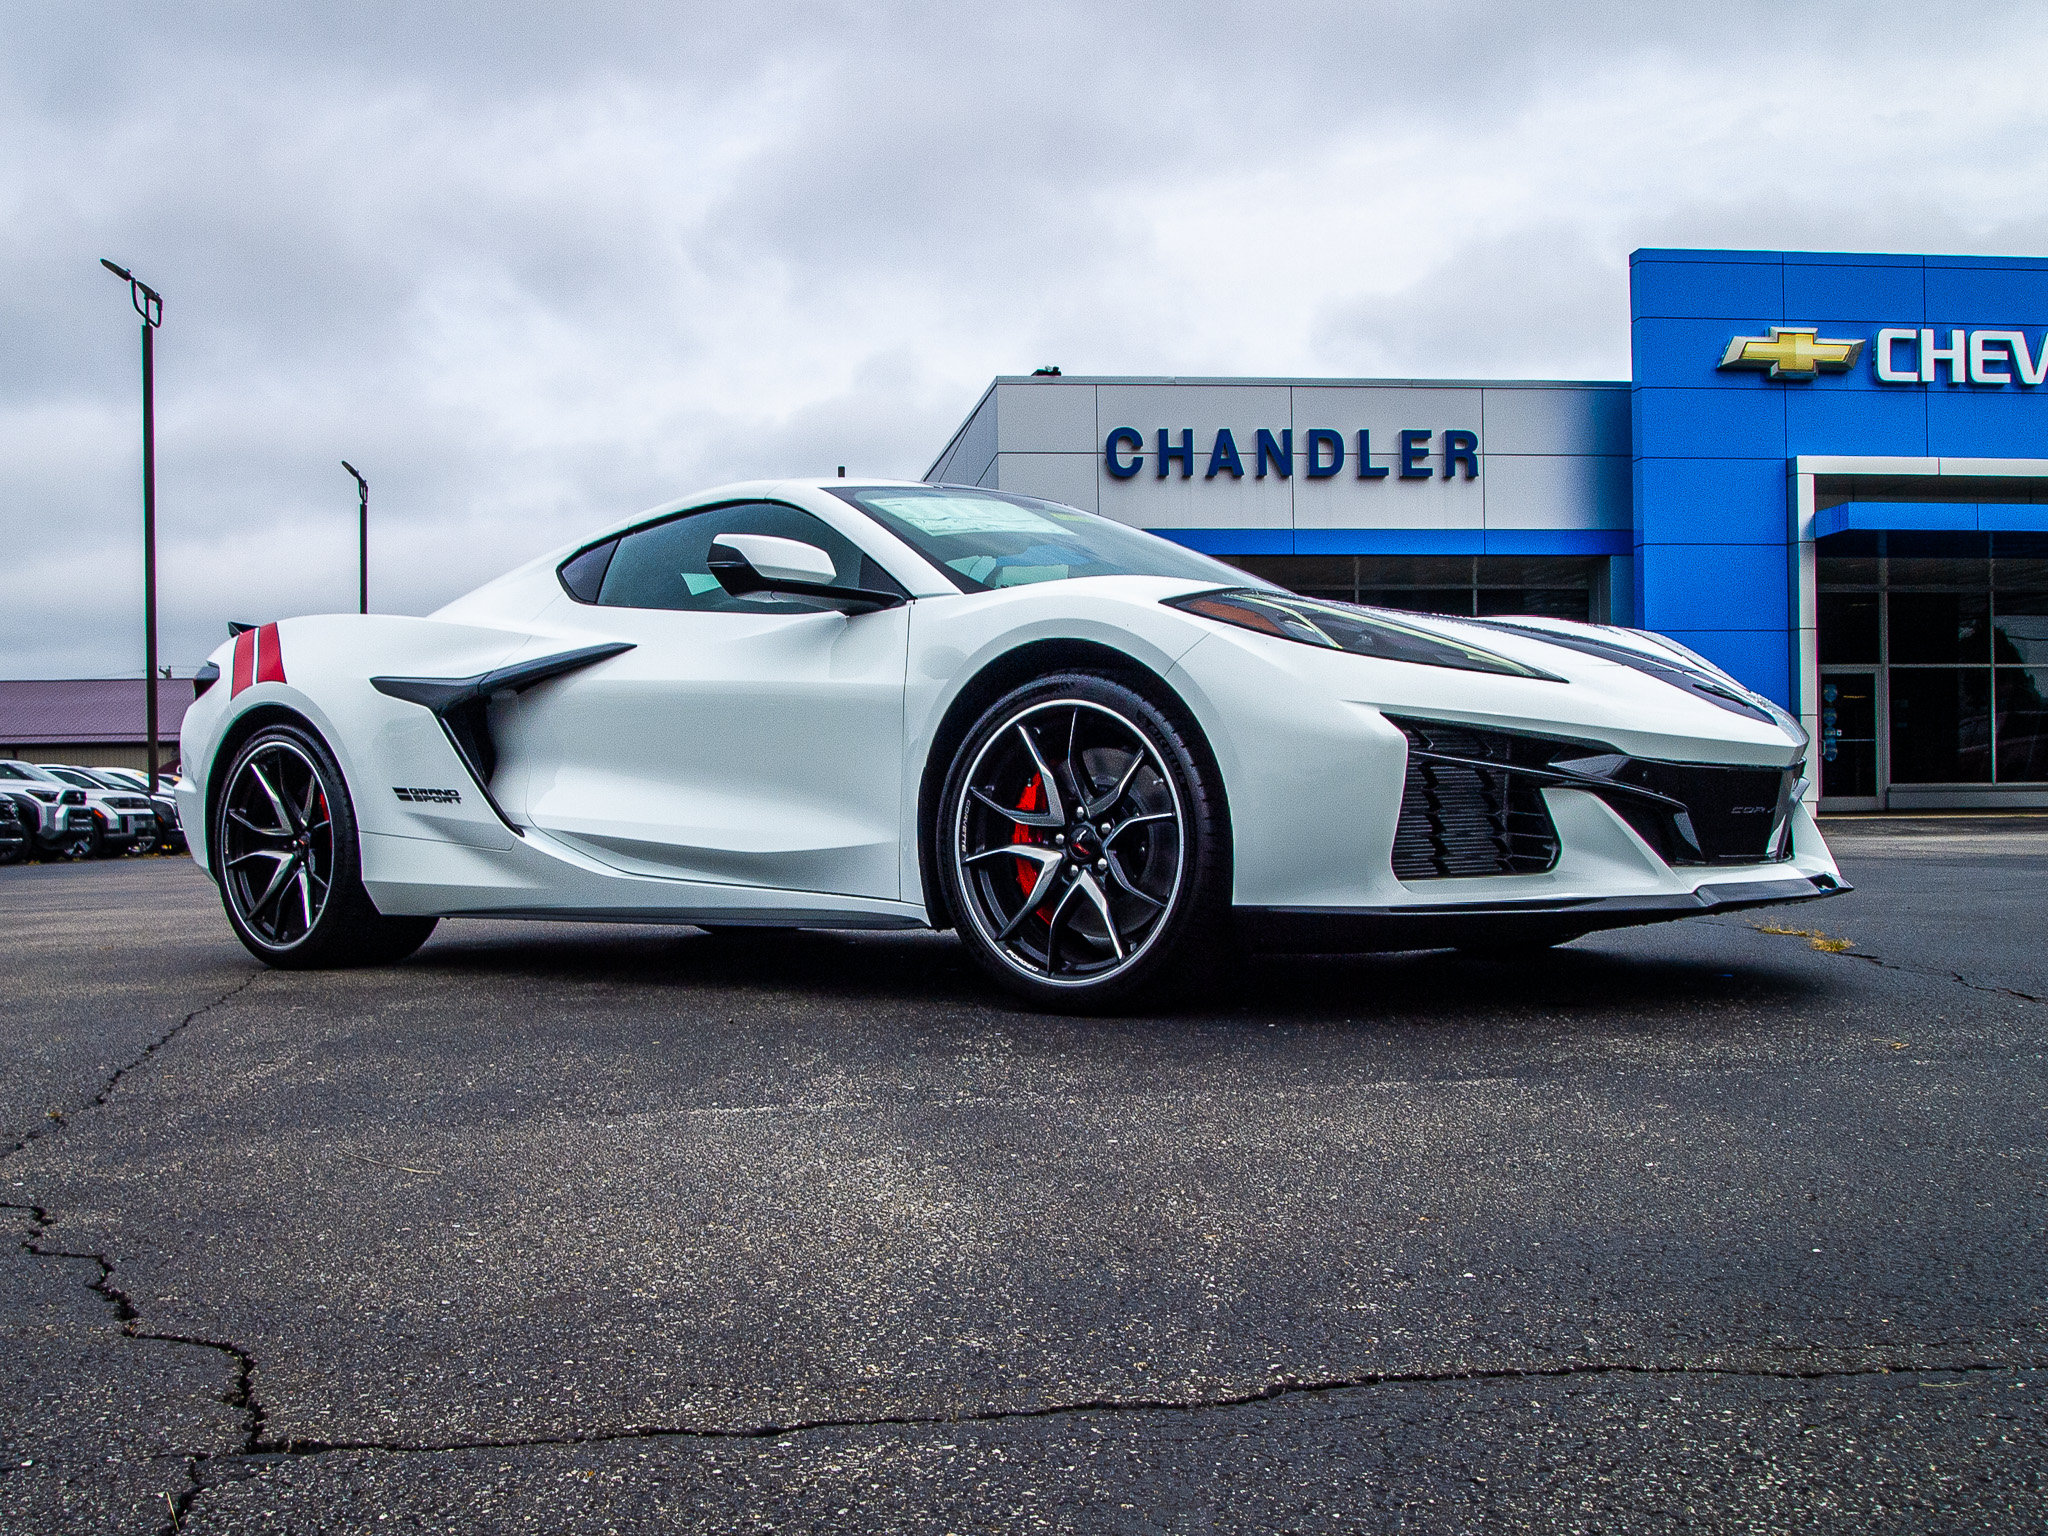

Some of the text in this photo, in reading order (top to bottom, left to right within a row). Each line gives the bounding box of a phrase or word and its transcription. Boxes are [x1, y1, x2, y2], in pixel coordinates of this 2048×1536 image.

[1873, 327, 2048, 386] CHEV
[1105, 426, 1480, 479] CHANDLER
[408, 787, 460, 797] GRAND
[412, 794, 462, 805] SPORT
[961, 799, 971, 852] CORVETTE
[1006, 949, 1039, 972] FORGED
